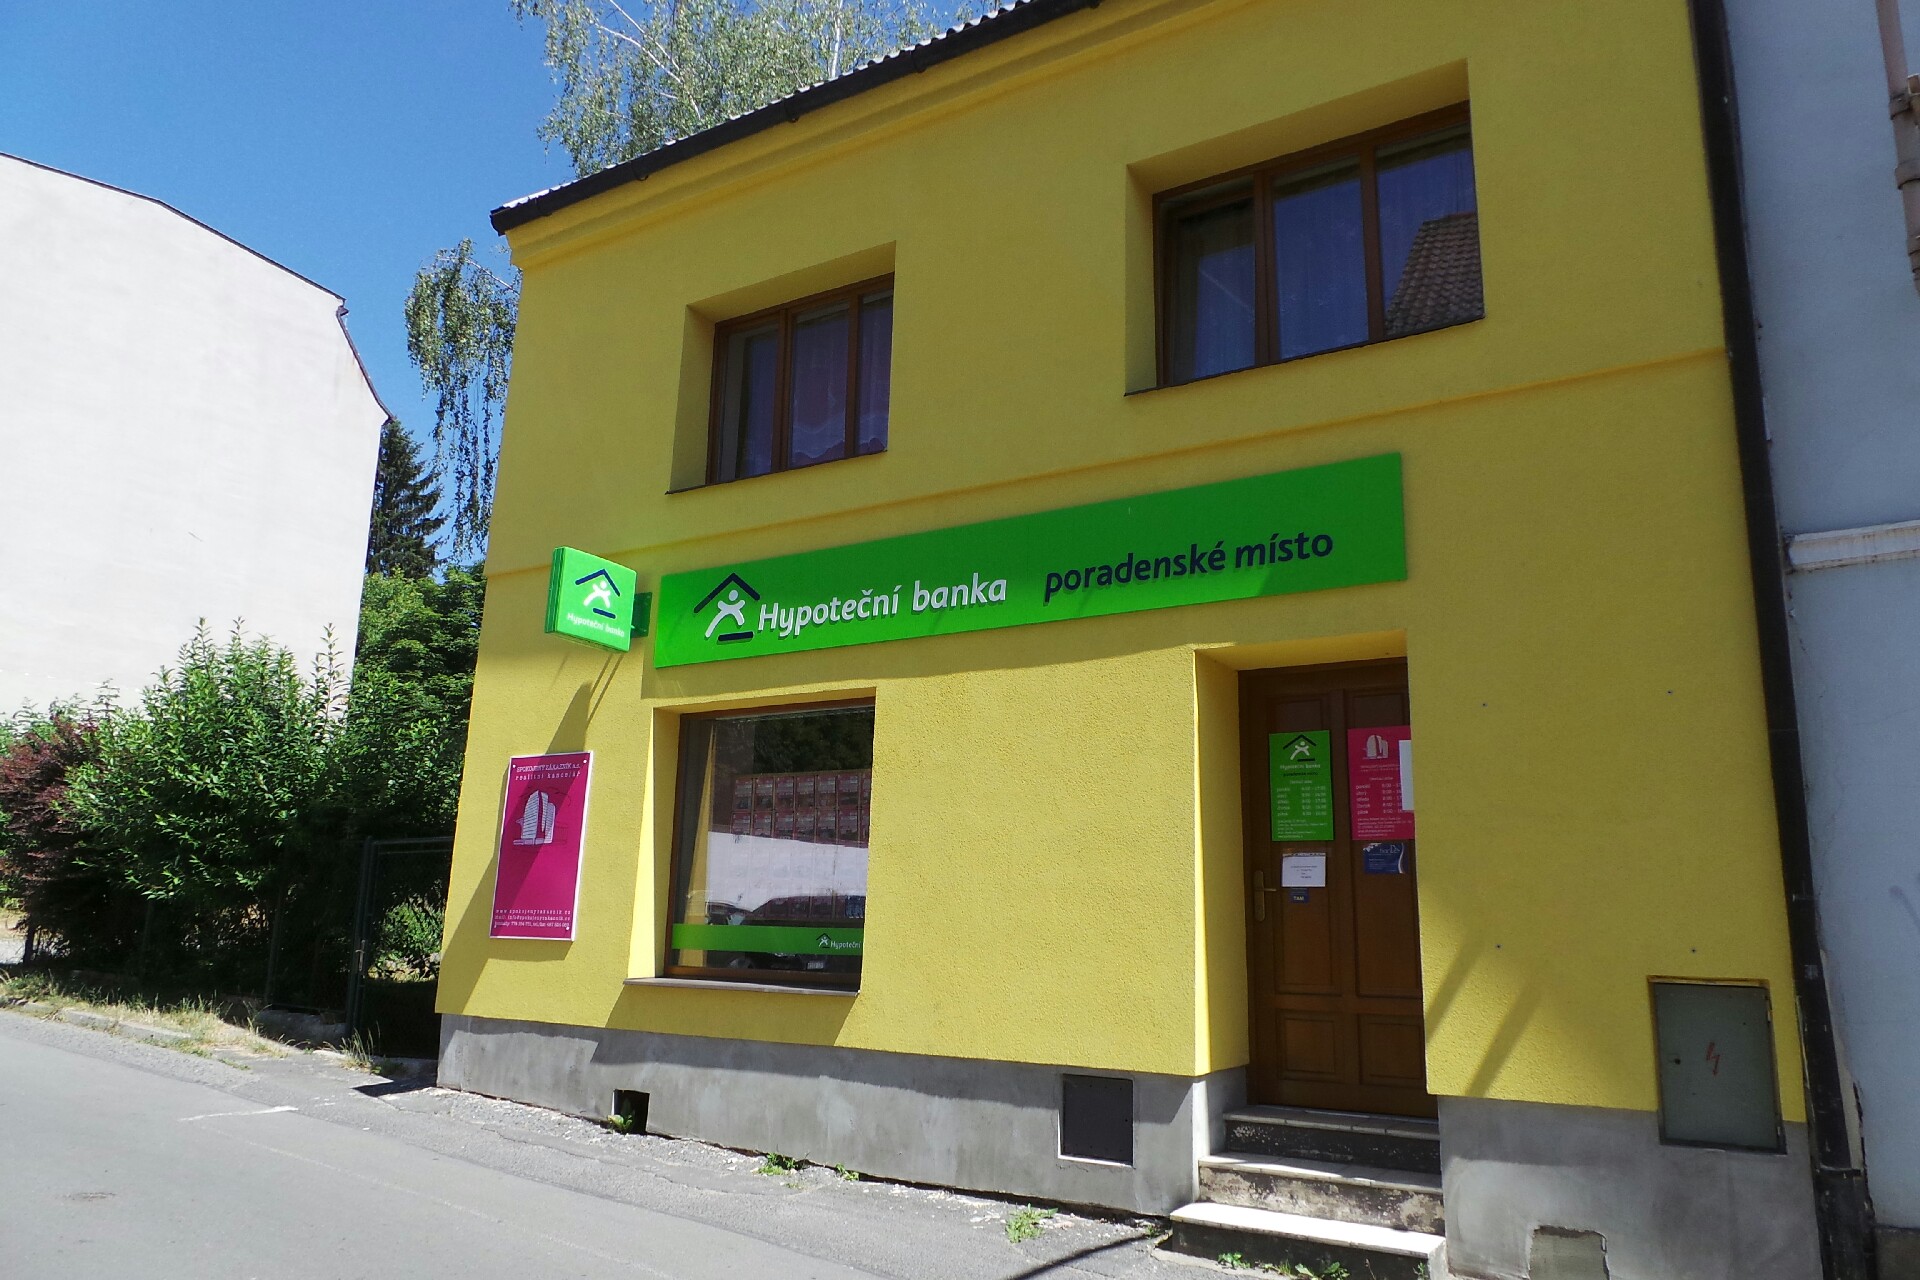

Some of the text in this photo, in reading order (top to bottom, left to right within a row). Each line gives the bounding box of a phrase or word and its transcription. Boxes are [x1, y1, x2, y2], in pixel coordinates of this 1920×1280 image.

[758, 532, 1334, 638] Hypoteční banka poradenské místo
[567, 612, 625, 638] Hypoteční banka
[830, 940, 861, 950] Hypoteční
